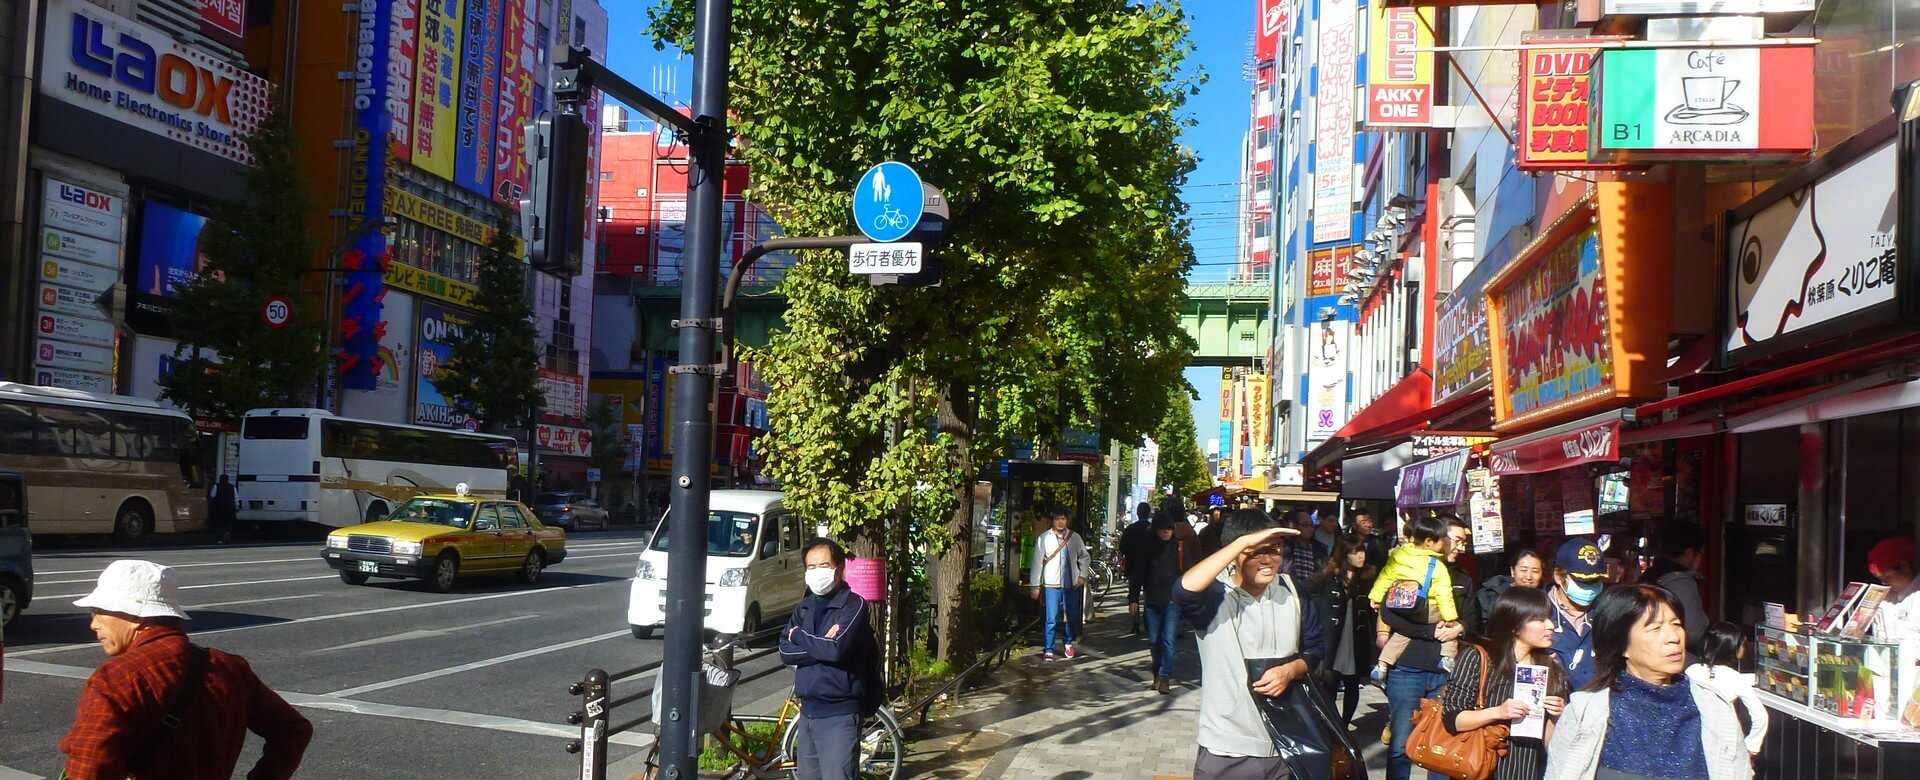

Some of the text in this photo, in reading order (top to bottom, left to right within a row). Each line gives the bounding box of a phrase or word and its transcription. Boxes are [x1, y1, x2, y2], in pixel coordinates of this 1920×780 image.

[1534, 52, 1594, 76] DVD
[1375, 88, 1424, 102] AKKY
[1533, 76, 1588, 102] ビデオ
[66, 71, 232, 147] Home Electronics Store
[1380, 103, 1419, 118] ONE
[1613, 123, 1642, 141] B1
[1669, 129, 1741, 144] ARCADIA
[497, 179, 524, 203] 4F
[419, 203, 453, 229] FREE
[852, 249, 918, 268] 歩行者優先
[1807, 247, 1896, 306] 秋葉原 くりこ庵
[269, 304, 286, 319] 50
